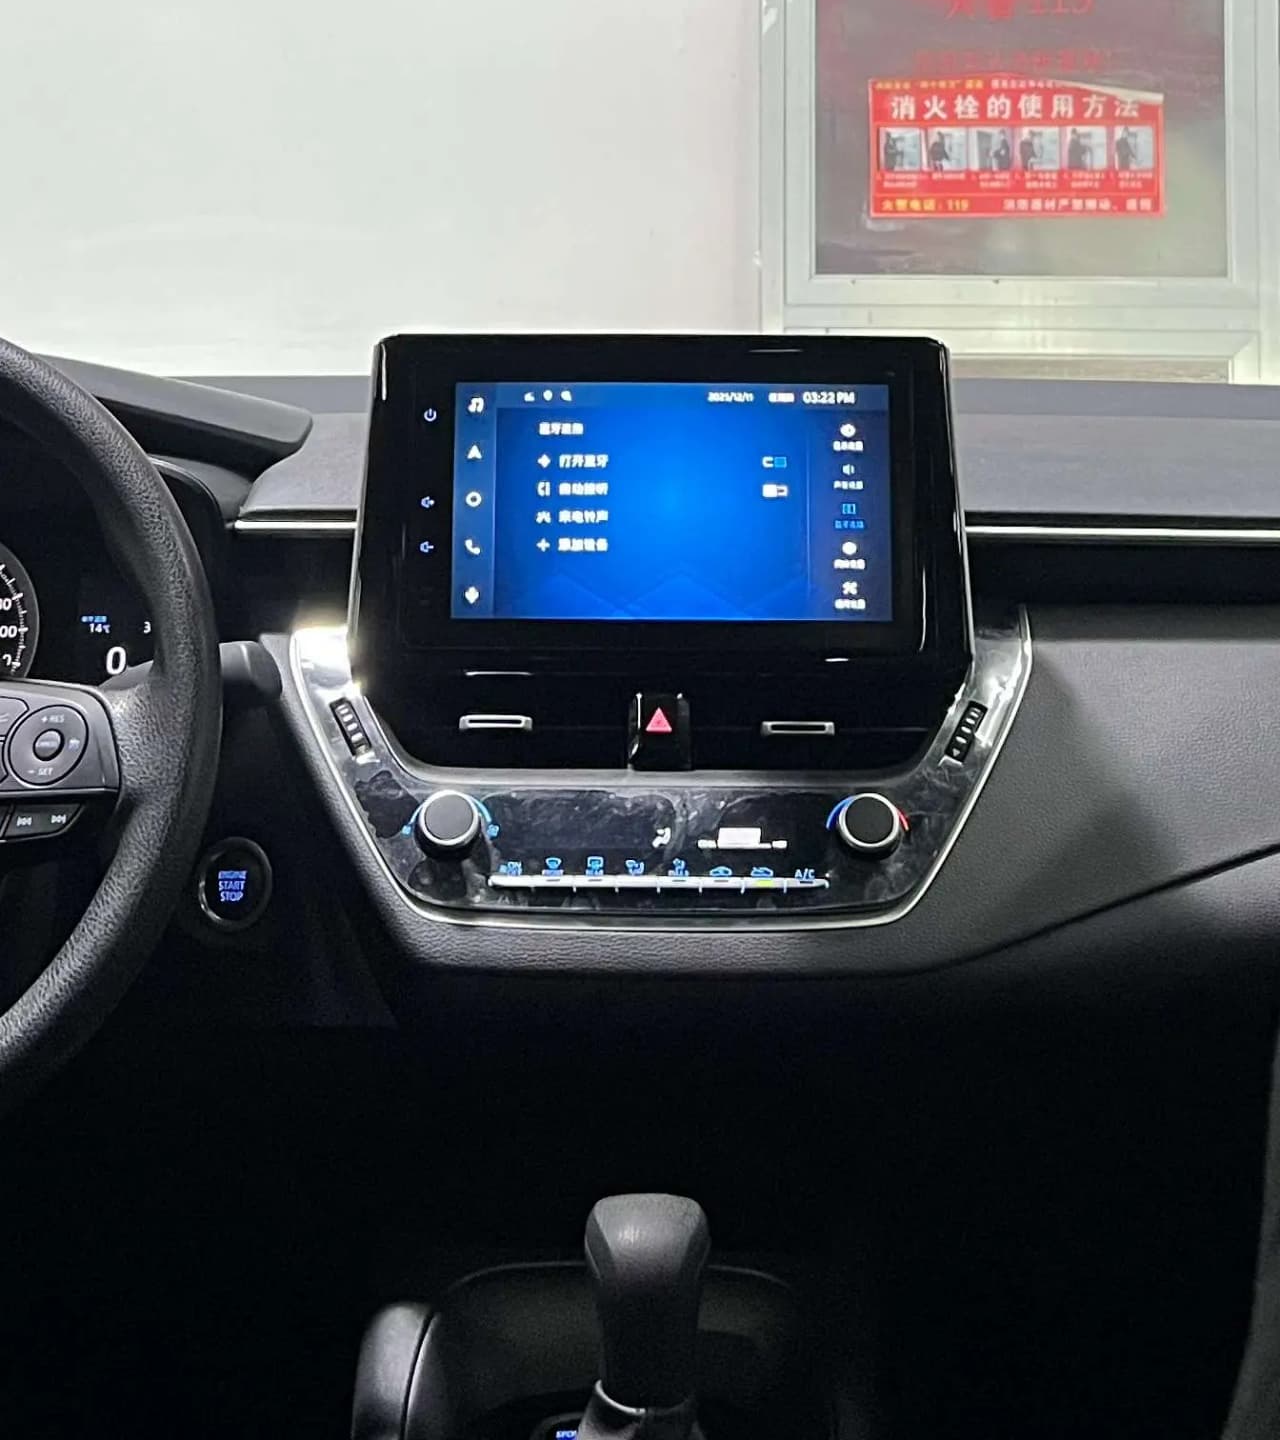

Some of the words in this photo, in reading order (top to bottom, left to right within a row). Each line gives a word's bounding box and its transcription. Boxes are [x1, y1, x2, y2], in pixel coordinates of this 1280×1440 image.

[890, 93, 1140, 121] 消火栓的使用方法
[803, 391, 835, 405] 03:22
[837, 391, 856, 404] PM
[106, 646, 127, 675] 0
[794, 868, 815, 880] A/C
[219, 880, 246, 892] START
[220, 891, 244, 902] STOP
